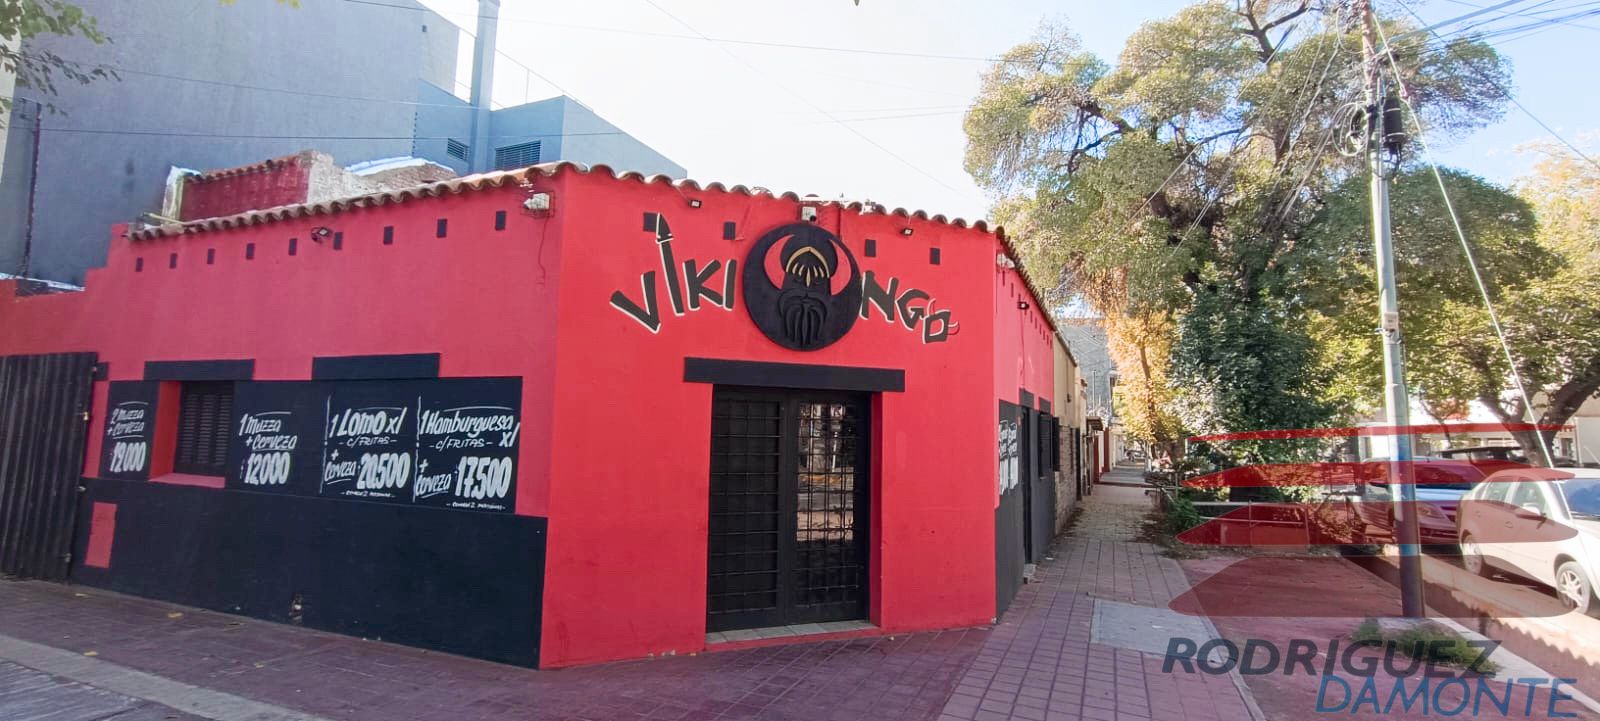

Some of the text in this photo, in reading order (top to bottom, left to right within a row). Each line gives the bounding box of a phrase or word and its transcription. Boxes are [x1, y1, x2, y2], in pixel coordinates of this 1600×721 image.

[239, 413, 248, 436] 1
[329, 414, 339, 438] 1
[420, 410, 514, 438] 1 Hamburguesa
